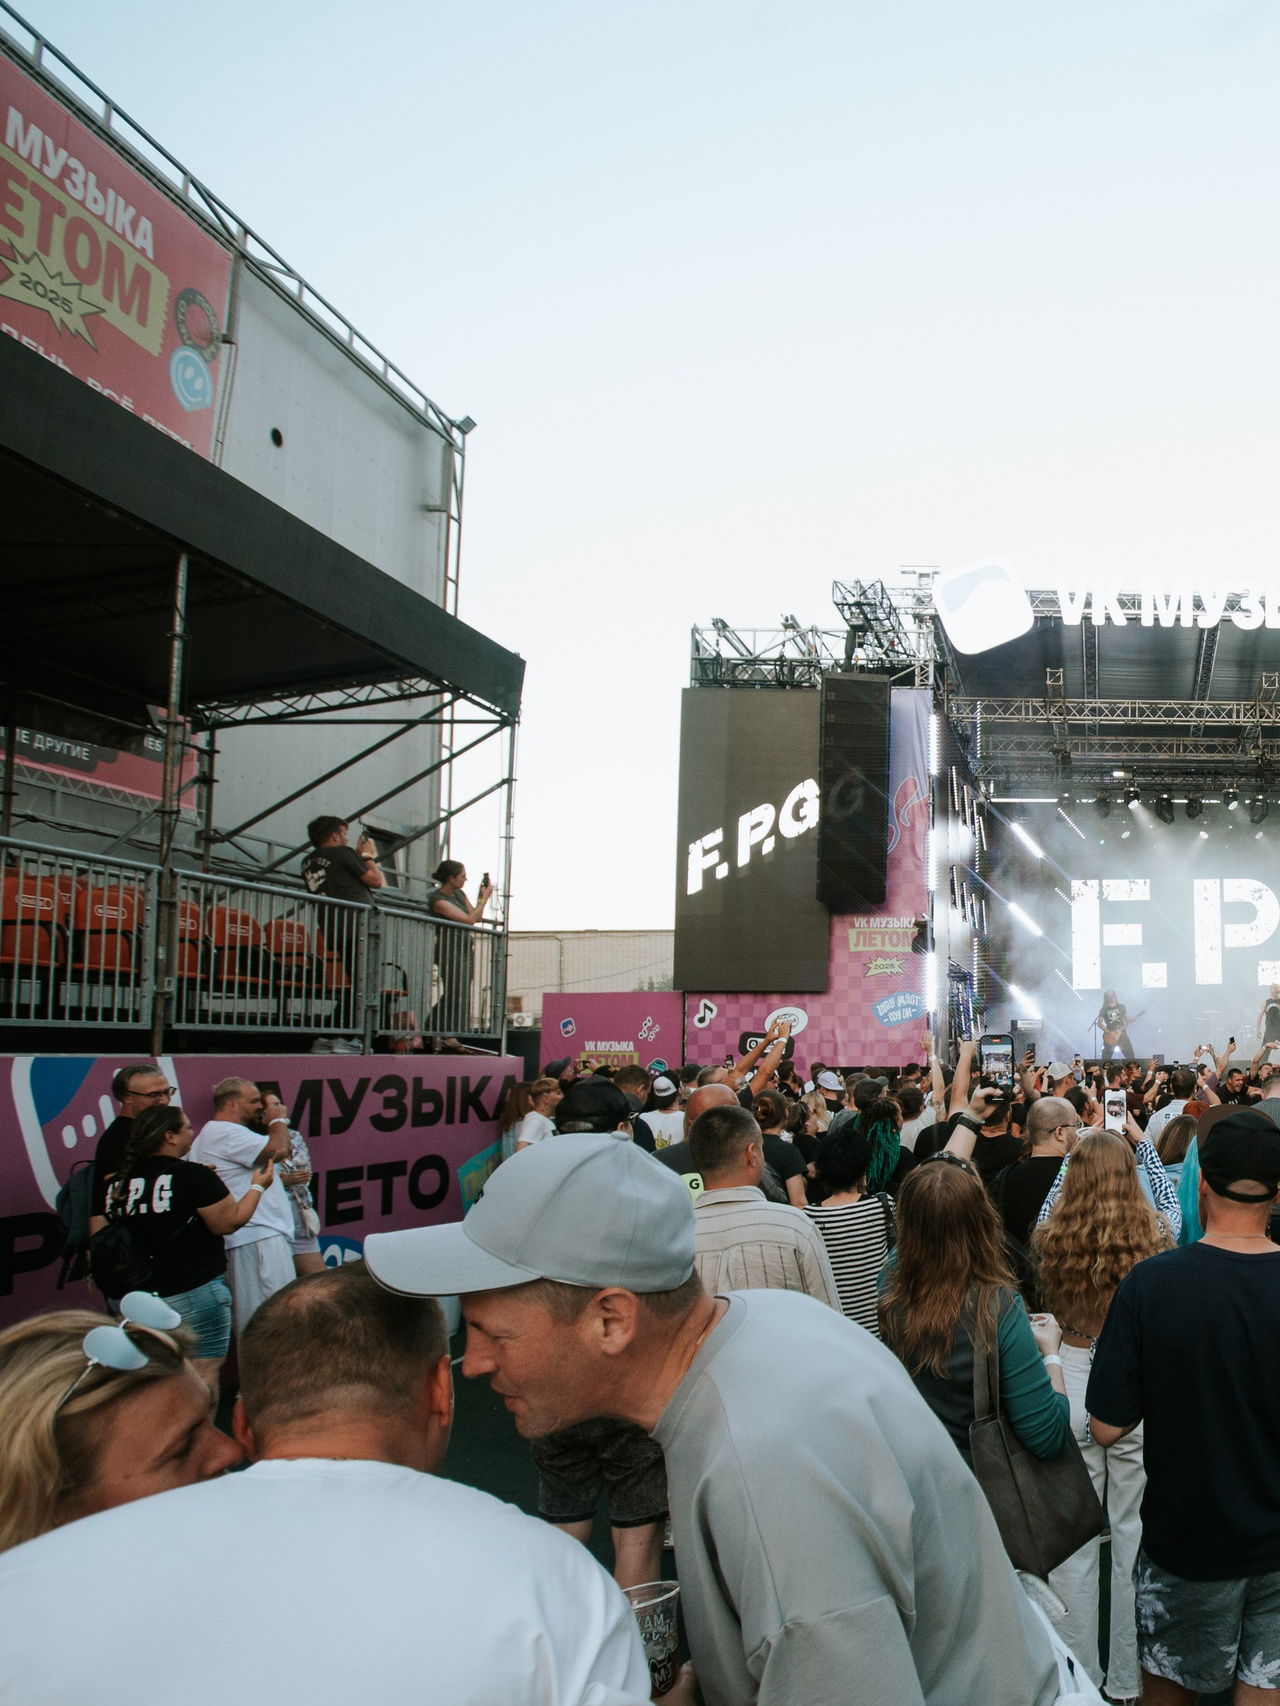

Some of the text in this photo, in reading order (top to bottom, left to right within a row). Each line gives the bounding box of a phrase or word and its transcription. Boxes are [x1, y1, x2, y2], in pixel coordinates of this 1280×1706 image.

[5, 106, 154, 260] МУЗЫКА
[19, 271, 73, 315] 2025
[1055, 574, 1127, 626] VK
[33, 734, 90, 761] ДРУГИЕ
[687, 778, 820, 895] F.P.G
[854, 917, 868, 928] VK
[584, 1040, 634, 1052] VK МУЗЫКА
[311, 1154, 450, 1227] ЕТО
